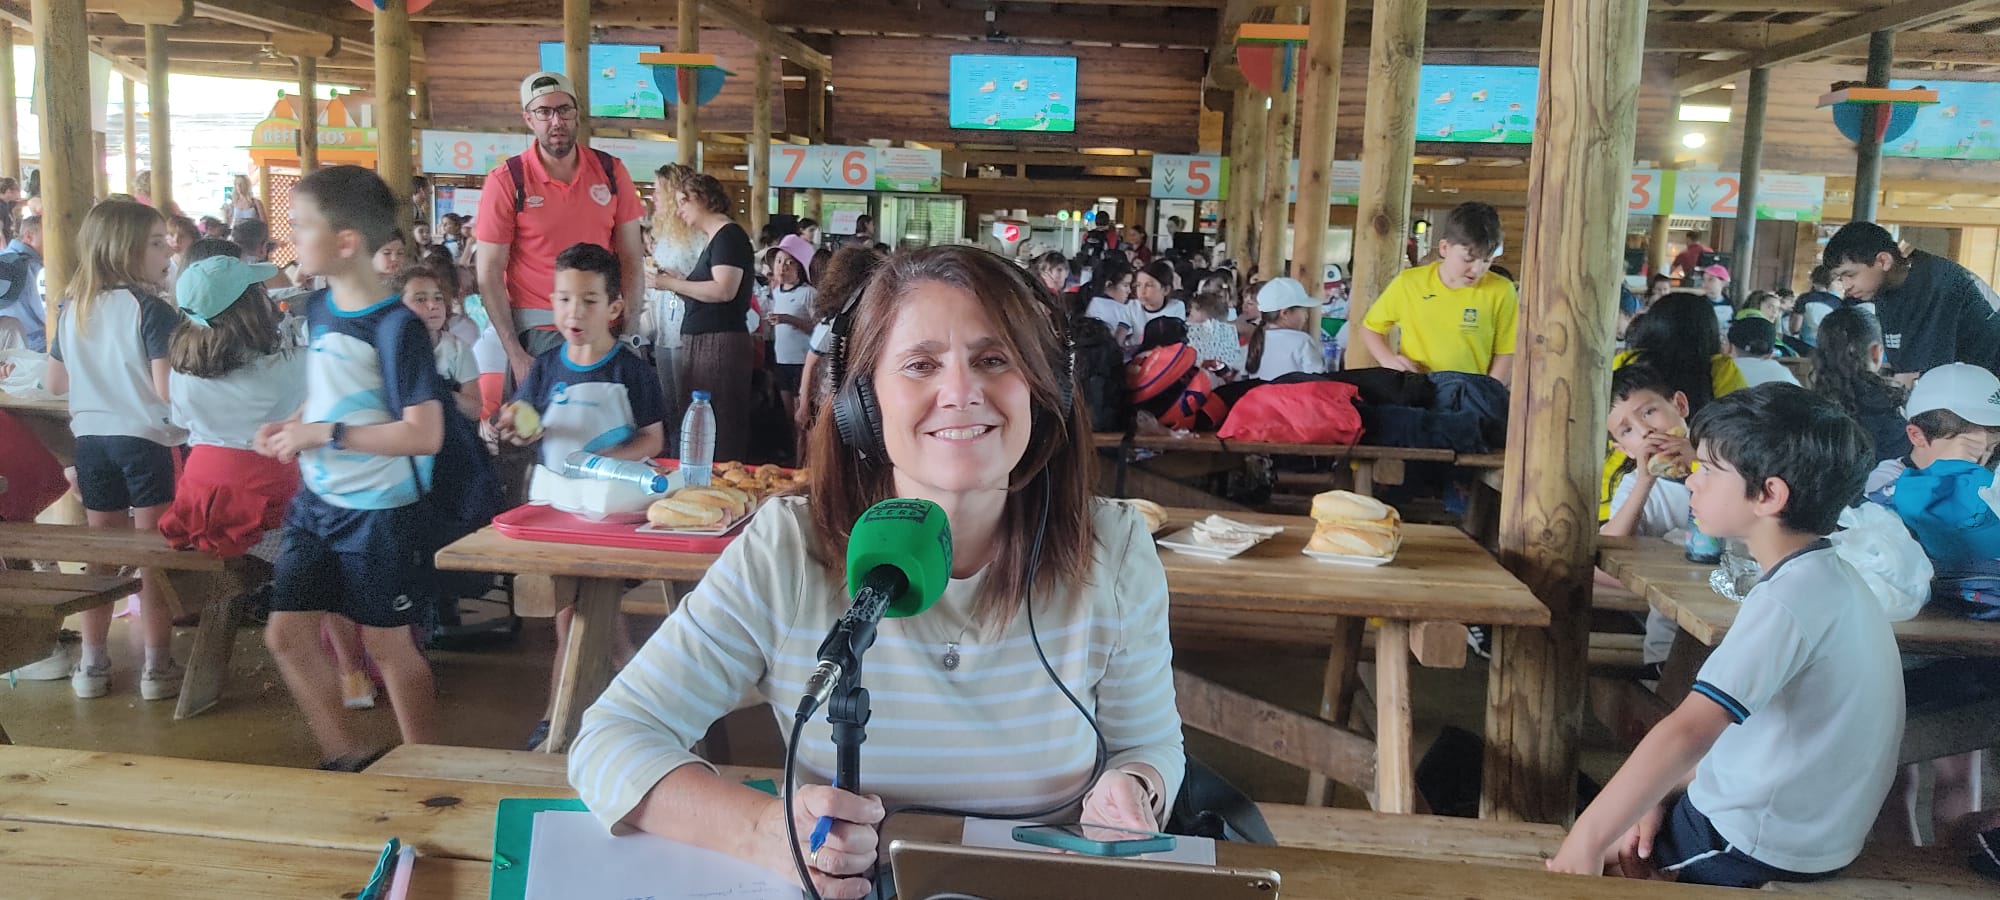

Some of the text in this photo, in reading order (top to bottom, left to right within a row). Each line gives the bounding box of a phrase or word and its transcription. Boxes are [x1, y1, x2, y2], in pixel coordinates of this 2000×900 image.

[453, 140, 474, 171] 8
[782, 148, 806, 184] 7
[842, 151, 868, 186] 6
[1185, 161, 1211, 195] 5
[1628, 174, 1652, 209] 3
[1710, 177, 1740, 213] 2
